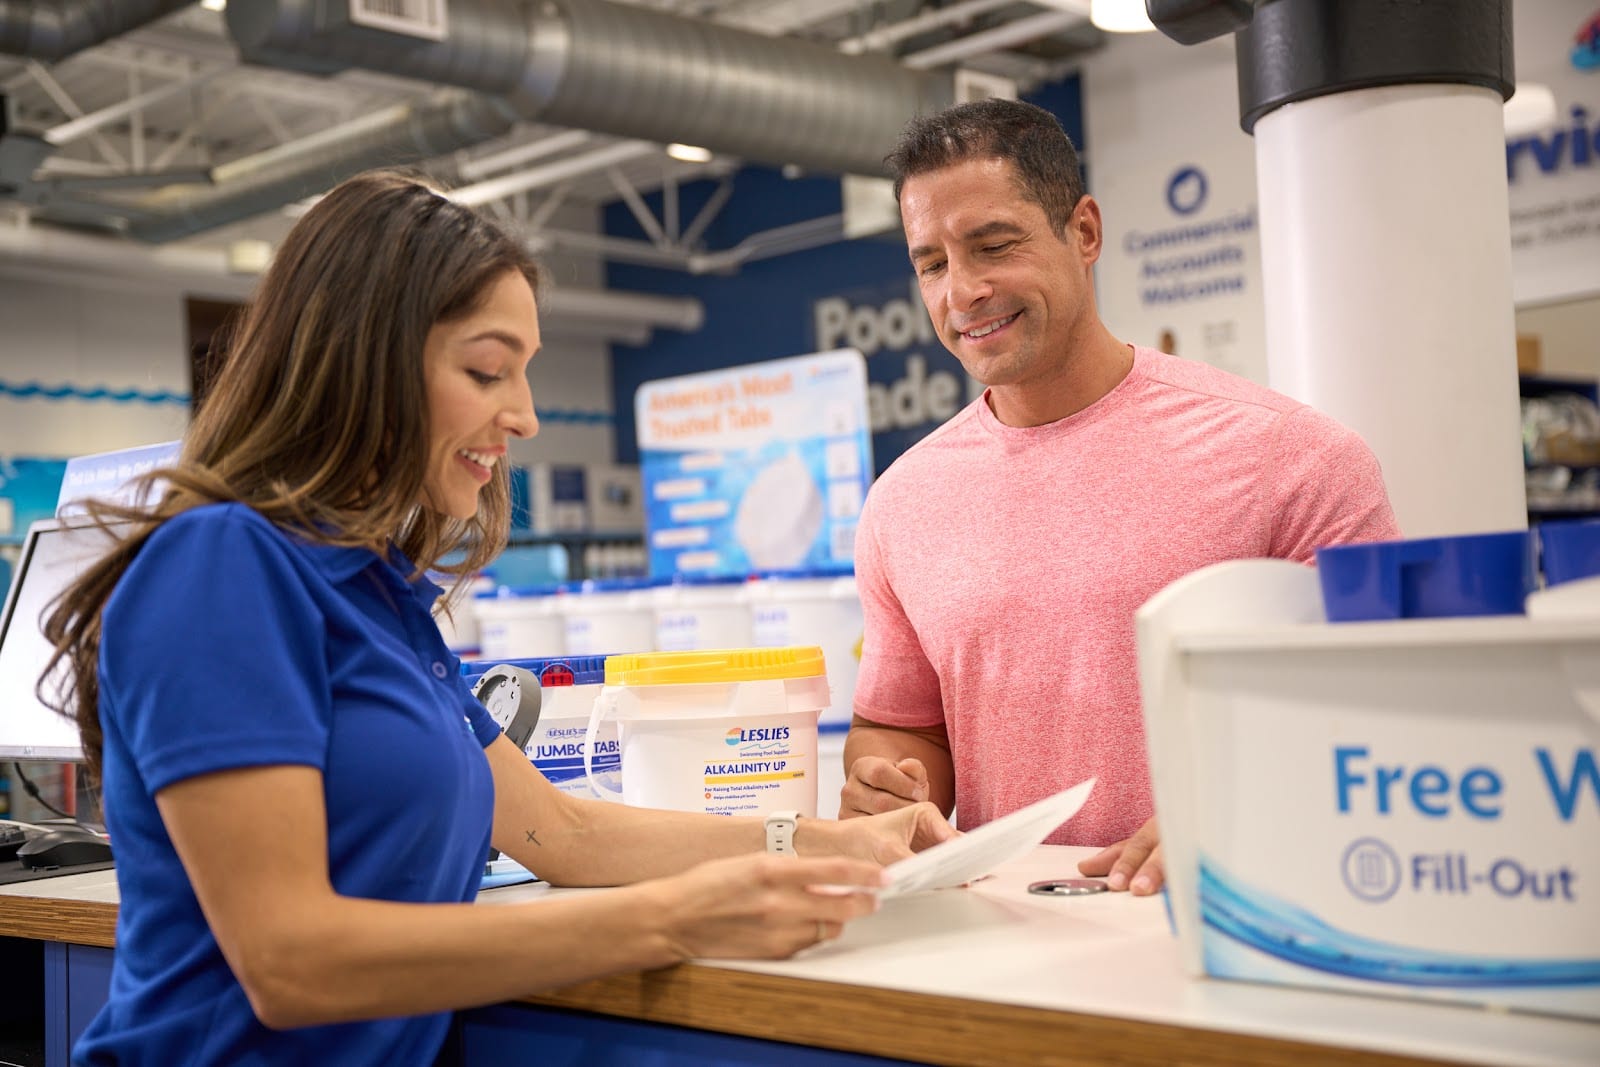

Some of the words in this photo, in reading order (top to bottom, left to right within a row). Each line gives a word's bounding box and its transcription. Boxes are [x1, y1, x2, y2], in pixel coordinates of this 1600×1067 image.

[1506, 104, 1600, 186] rvi
[740, 727, 790, 742] LESLIE'S
[704, 762, 770, 776] ALKALINITY
[773, 760, 786, 771] UP
[1334, 747, 1504, 820] Free
[1411, 853, 1576, 901] Fill-Out
